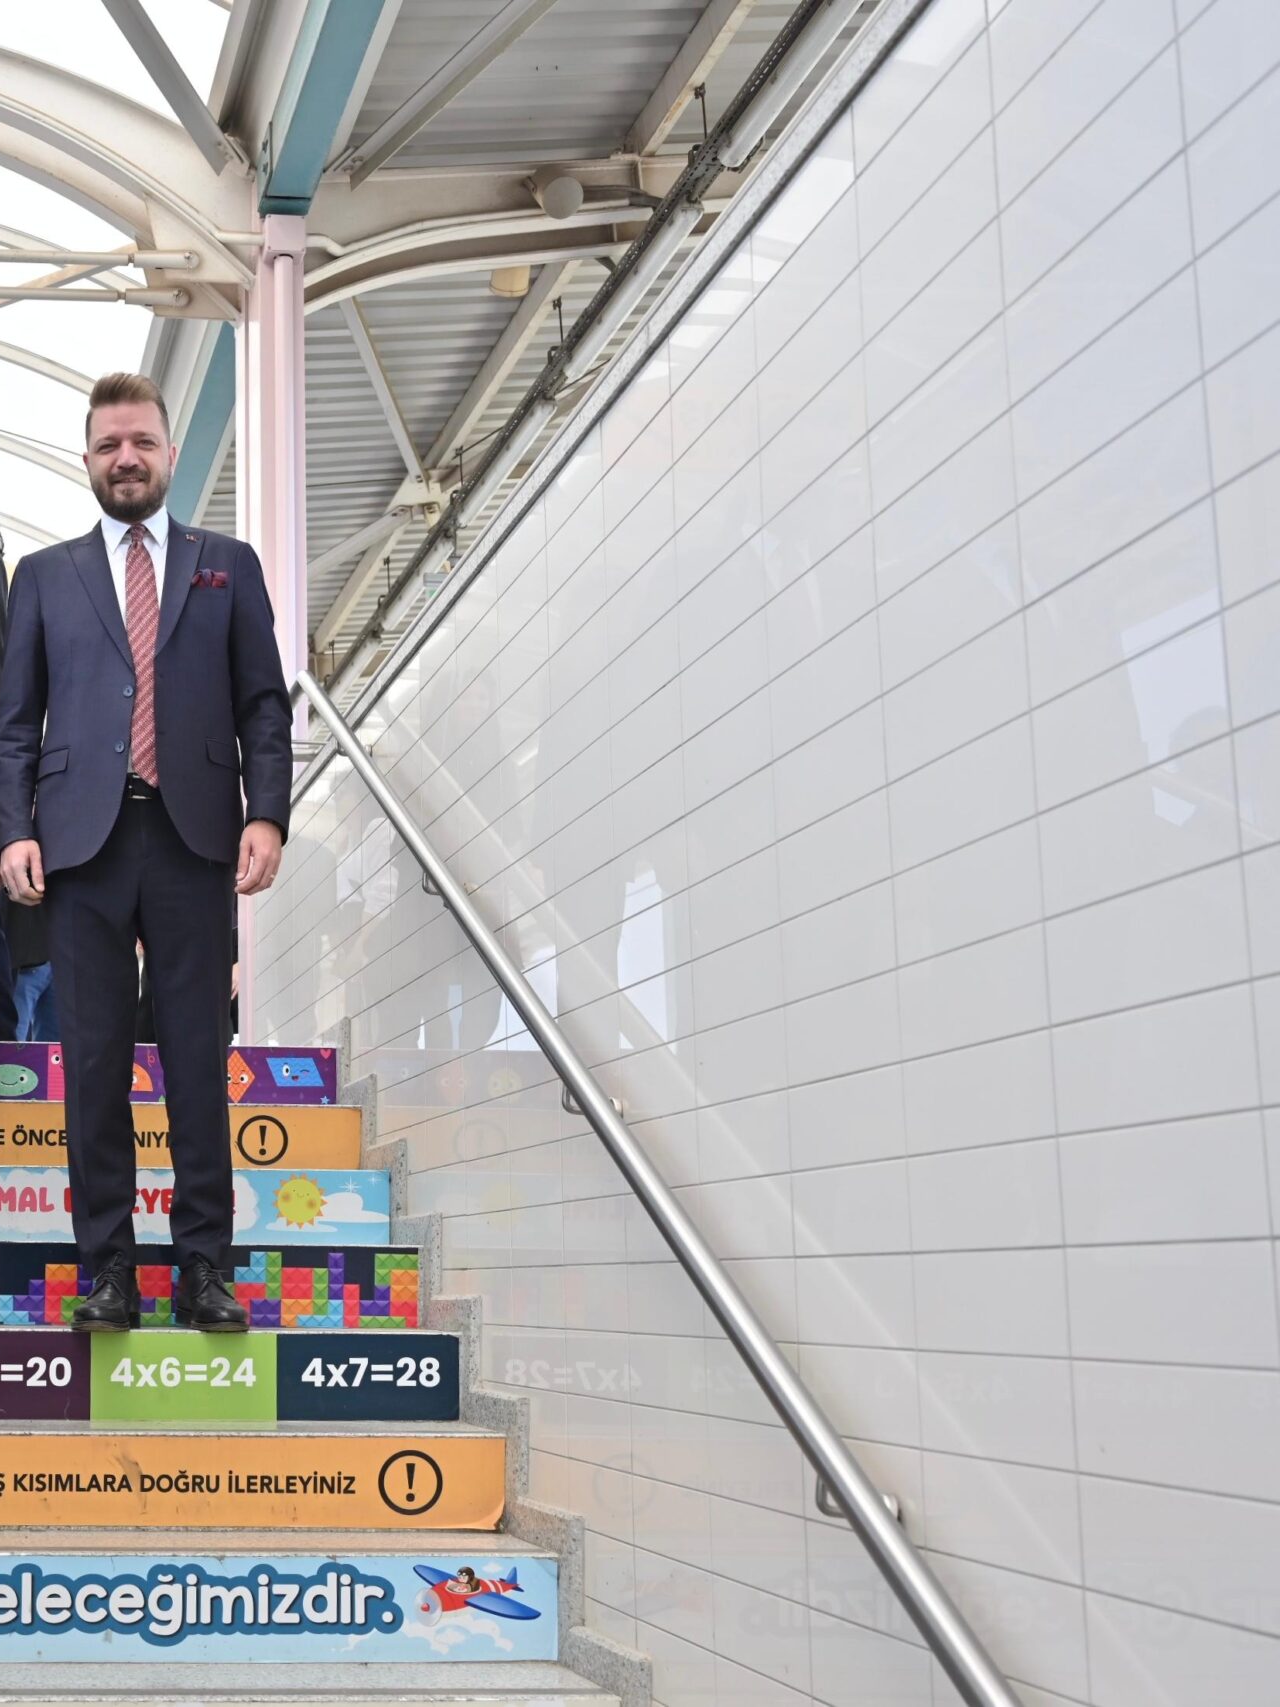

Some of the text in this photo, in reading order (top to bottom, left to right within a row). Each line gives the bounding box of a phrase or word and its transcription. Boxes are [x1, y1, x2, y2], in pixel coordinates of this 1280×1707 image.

[110, 1356, 257, 1388] 4x6=24
[301, 1356, 442, 1388] 4x7=28
[13, 1473, 133, 1493] KISIMLARA
[139, 1469, 220, 1494] DOĞRU
[227, 1470, 357, 1495] İLERLEYİNİZ
